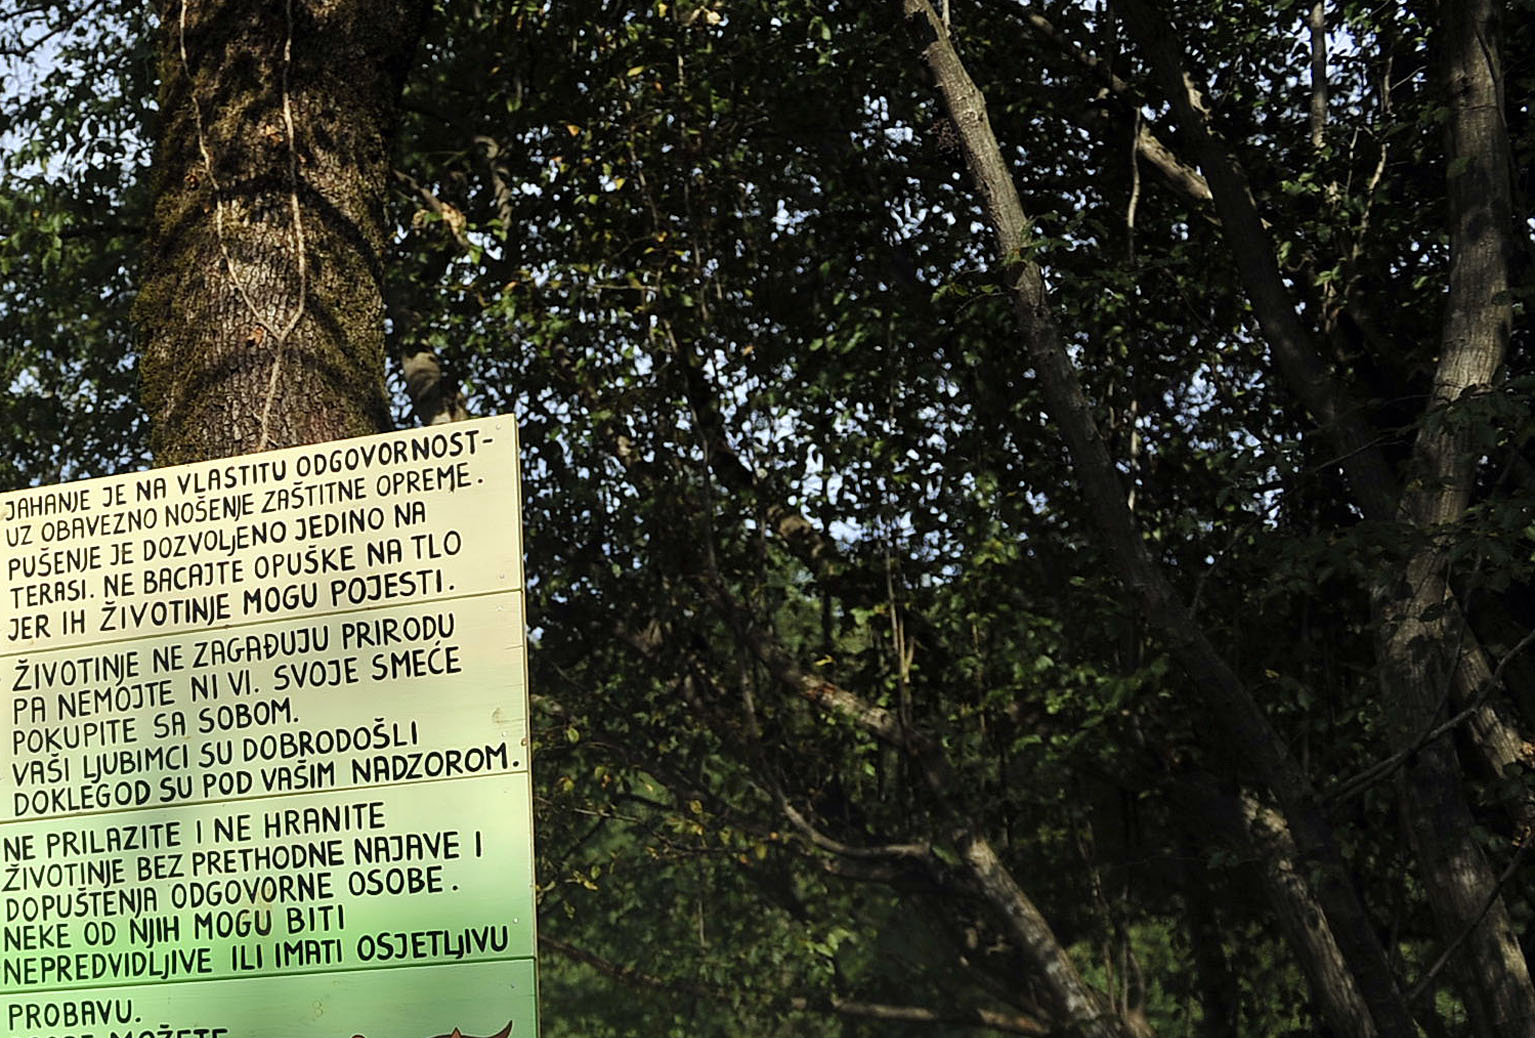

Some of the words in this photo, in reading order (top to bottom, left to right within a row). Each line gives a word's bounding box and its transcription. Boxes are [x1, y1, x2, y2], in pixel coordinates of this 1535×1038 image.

[4, 489, 91, 522] JAHANJE
[102, 483, 127, 508] JE
[136, 477, 167, 502] NA
[177, 460, 286, 495] VLASTITU
[5, 524, 33, 548] UZ
[41, 507, 158, 543] OBAVEZNO
[165, 492, 255, 528] NOŠENJE
[260, 477, 367, 514] ZAŠTITNE
[376, 461, 484, 497] OPREME.
[8, 545, 102, 581] PUŠENJE
[109, 541, 134, 566] JE
[143, 520, 287, 562] DOZVOLJENO
[294, 507, 385, 542] JEDINO
[394, 500, 426, 529] NA
[9, 578, 95, 610] TERASI.
[103, 572, 135, 598] NE
[143, 559, 244, 595] BACAJTE
[254, 544, 357, 580] OPUŠKE
[366, 538, 403, 568] NA
[410, 530, 462, 560] TLO
[7, 613, 52, 642] JER
[62, 609, 86, 636] IH
[99, 592, 231, 632] ŽIVOTINJE
[243, 581, 318, 616] MOGU
[330, 568, 455, 607] POJESTI.
[12, 651, 140, 692] ŽIVOTINJE
[152, 644, 185, 674] NE
[192, 624, 329, 669] ZAGAĐUJU
[341, 612, 455, 651] PRIRODU
[13, 696, 46, 726] PA
[57, 679, 176, 721] NEMOJTE
[190, 673, 218, 703] NI
[227, 669, 260, 697] VI.
[273, 656, 360, 691] SVOJE
[371, 639, 462, 681] SMEĆE
[11, 752, 70, 787] VAŠI
[83, 743, 189, 785] LJUBIMCI
[198, 739, 233, 769] SU
[242, 717, 418, 764] DOBRODOŠLI
[13, 718, 137, 755] POKUPITE
[153, 711, 186, 739] SA
[198, 696, 299, 734] SOBOM.
[13, 779, 151, 817] DOKLEGOD
[159, 775, 193, 803] SU
[202, 770, 253, 799] POD
[260, 758, 335, 792] VAŠIM
[351, 741, 520, 785] NADZOROM.
[1, 858, 126, 893] ŽIVOTINJE
[136, 853, 185, 882] BEZ
[191, 839, 345, 877] PRETHODNE
[353, 830, 460, 866] NAJAVE
[475, 830, 482, 858] I
[3, 834, 36, 863] NE
[46, 821, 182, 859] PRILAZITE
[196, 819, 202, 845] I
[213, 814, 252, 844] NE
[264, 801, 386, 839] HRANITE
[6, 886, 158, 923] DOPUŠTENJA
[171, 871, 334, 910] ODGOVORNE
[348, 865, 459, 897] OSOBE.
[3, 923, 72, 953] NEKE
[83, 921, 117, 946] OD
[129, 915, 180, 949] NJIH
[194, 908, 272, 941] MOGU
[286, 904, 345, 935] BITI
[3, 947, 213, 986] NEPREDVIDLJIVE
[231, 943, 263, 972] ILI
[274, 938, 343, 969] IMATI
[356, 925, 509, 962] OSJETLJIVU
[8, 999, 142, 1031] PROBAVU.
